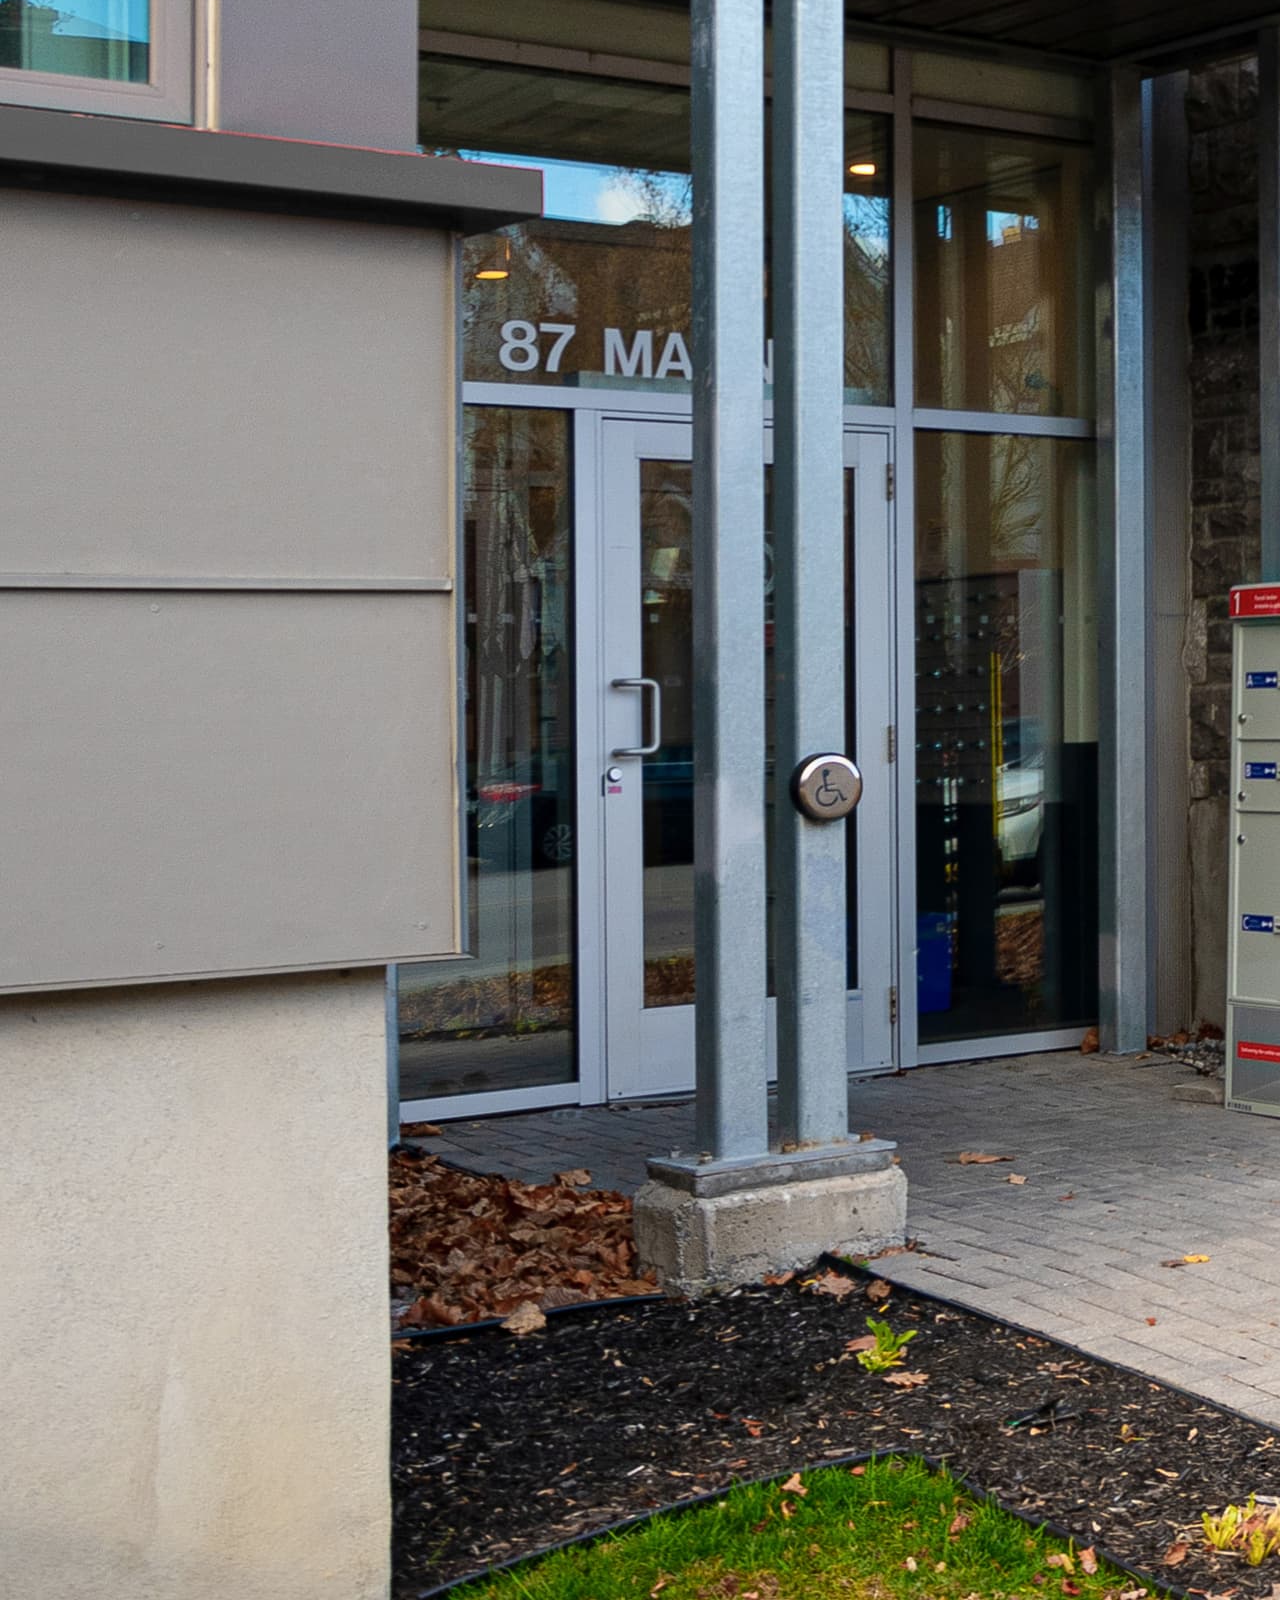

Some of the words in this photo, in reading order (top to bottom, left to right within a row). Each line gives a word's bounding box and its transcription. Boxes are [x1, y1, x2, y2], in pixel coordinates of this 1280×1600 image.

[500, 319, 576, 374] 87
[1233, 592, 1241, 615] 1
[1246, 674, 1254, 687] A
[1243, 916, 1250, 930] C
